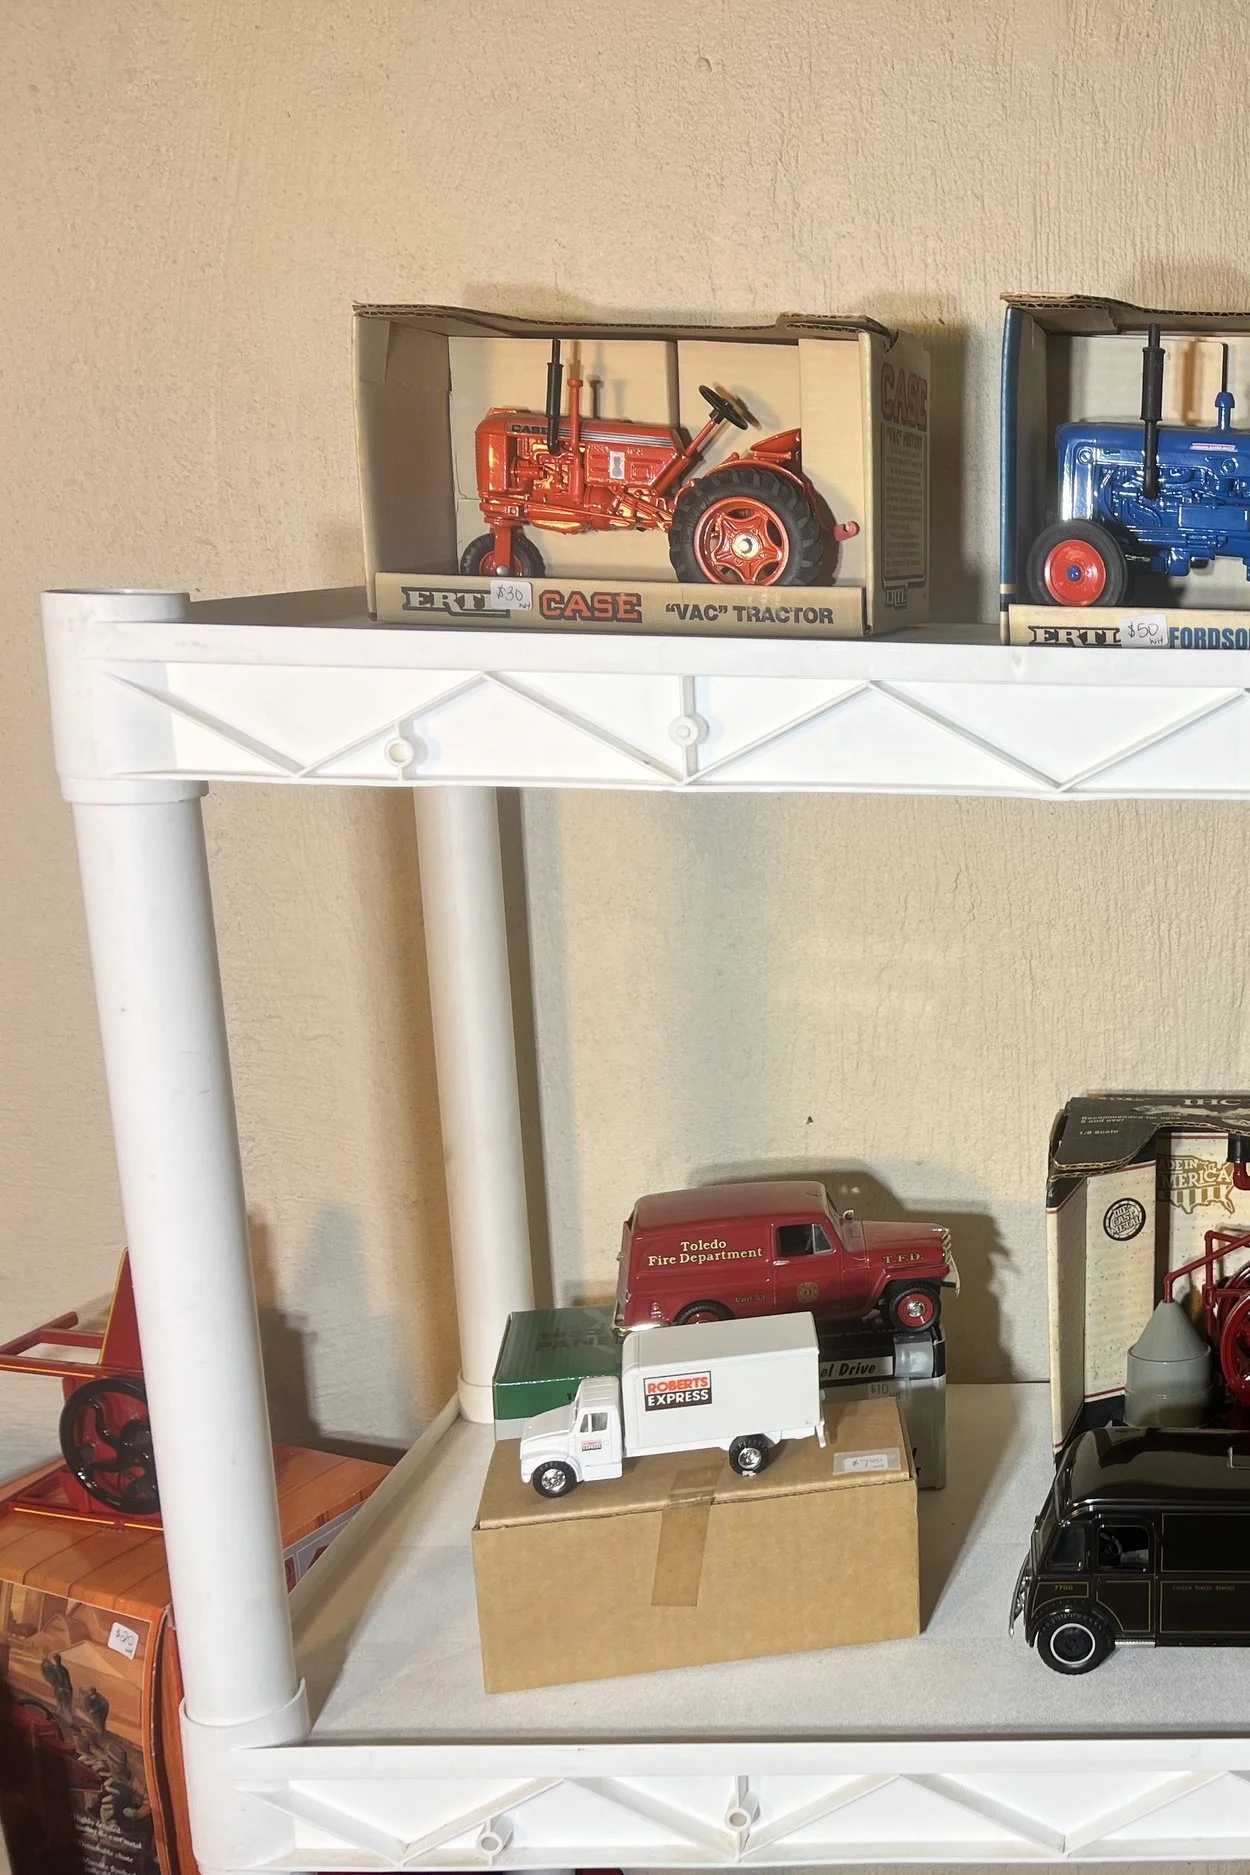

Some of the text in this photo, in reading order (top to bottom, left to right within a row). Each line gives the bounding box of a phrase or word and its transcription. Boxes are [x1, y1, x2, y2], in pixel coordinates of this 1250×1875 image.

[881, 361, 928, 432] CASE
[497, 585, 524, 603] $30
[538, 590, 643, 624] CASE
[665, 602, 834, 625] "VAC" TRACTOR
[1127, 621, 1160, 638] $50
[1184, 1159, 1199, 1170] IN
[1158, 1169, 1232, 1189] MERICA
[680, 1237, 727, 1253] Toledo
[648, 1246, 764, 1267] Fire Department
[838, 1361, 877, 1377] Drive
[647, 1376, 709, 1393] ROBERTS
[648, 1389, 709, 1407] EXPRESS
